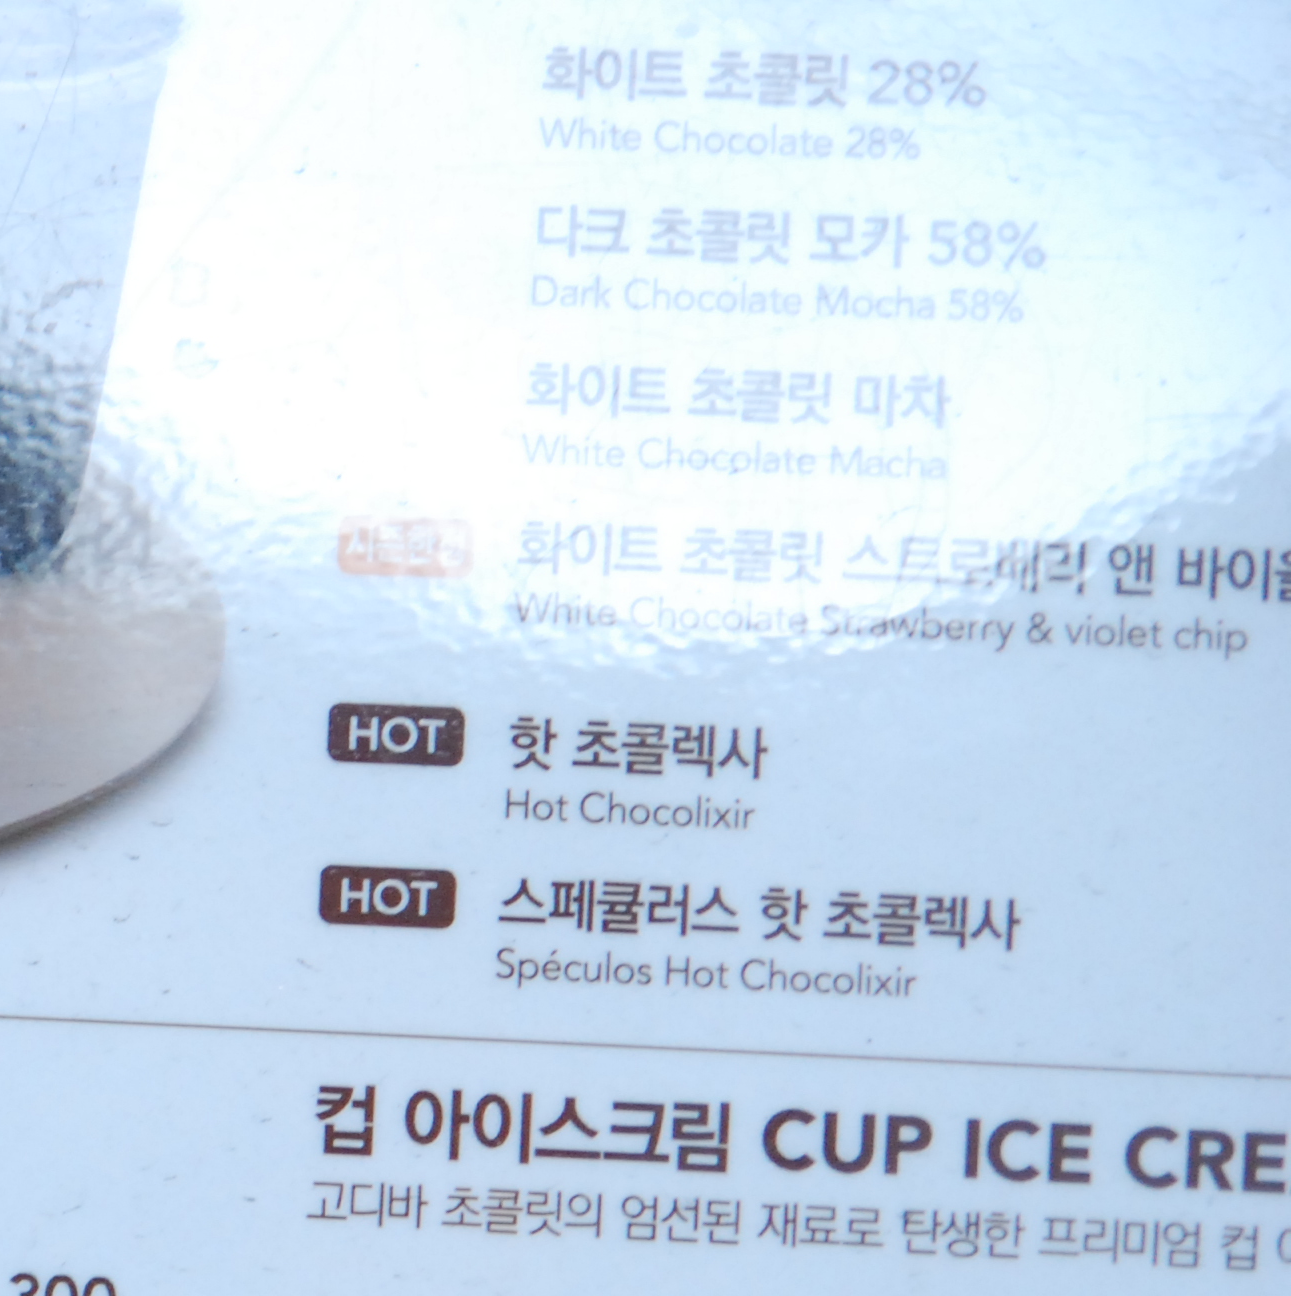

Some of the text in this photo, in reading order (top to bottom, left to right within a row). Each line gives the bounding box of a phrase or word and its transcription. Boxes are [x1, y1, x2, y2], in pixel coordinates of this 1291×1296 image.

[542, 44, 988, 110] 화이트 초콜릿 28%
[536, 204, 1048, 272] 다크 초콜릿 모카 58%
[1108, 543, 1154, 599] 앤
[822, 604, 1249, 658] Strawberry & violet chip
[347, 714, 770, 782] HOT 핫 초콜렉사
[505, 790, 755, 831] Hot Chocolixir
[340, 876, 1021, 952] HOT 스페큘러스 핫 초콜렉사
[496, 949, 917, 998] Spéculos Hot Chocolixir
[315, 1087, 1287, 1194] 컵 아이스크림 CUP ICE CRE
[306, 1181, 427, 1231] 고디바
[441, 1189, 604, 1241] 초콜릿의
[621, 1194, 742, 1243] 엄선된
[758, 1201, 884, 1250] 재료로
[902, 1209, 1024, 1259] 탄생한
[1039, 1216, 1201, 1269] 프리미엄
[1222, 1226, 1259, 1271] 컵
